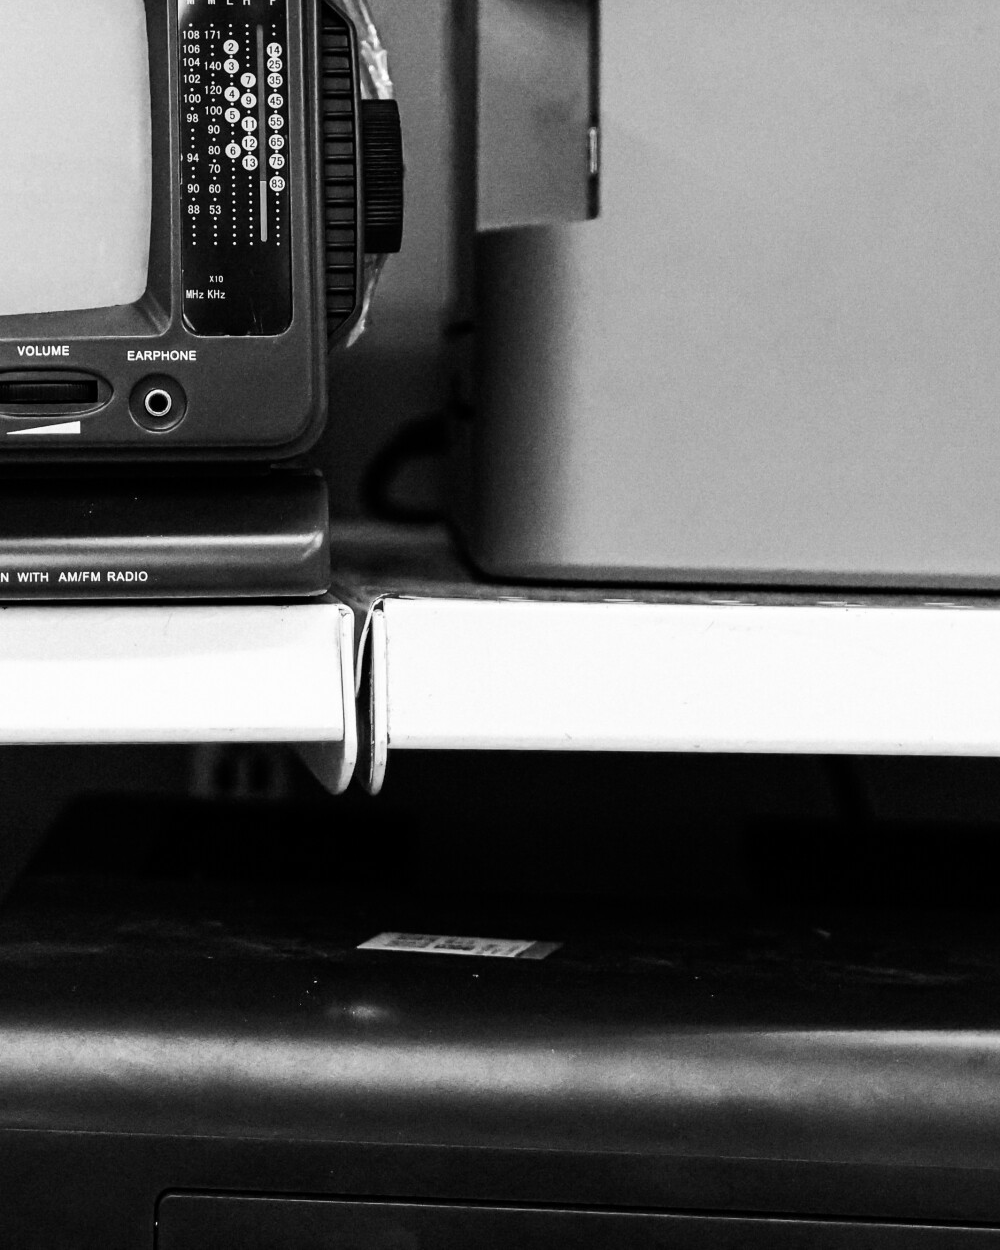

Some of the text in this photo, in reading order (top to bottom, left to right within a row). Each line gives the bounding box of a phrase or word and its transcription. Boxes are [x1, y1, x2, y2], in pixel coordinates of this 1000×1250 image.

[182, 30, 200, 40] 108
[204, 30, 221, 40] 171
[182, 44, 201, 54] 106
[268, 44, 281, 56] 14
[182, 57, 201, 67] 104
[204, 61, 222, 71] 140
[268, 59, 282, 70] 25
[183, 73, 201, 84] 102
[268, 74, 282, 86] 35
[204, 84, 223, 95] 120
[183, 93, 202, 104] 100
[268, 95, 283, 107] 45
[204, 105, 223, 116] 100
[186, 113, 199, 123] 98
[269, 116, 283, 128] 55
[207, 124, 221, 135] 90
[243, 119, 256, 130] 11
[243, 137, 256, 149] 12
[269, 136, 284, 148] 65
[207, 145, 221, 155] 80
[186, 152, 200, 163] 94
[243, 157, 257, 169] 13
[270, 155, 284, 167] 75
[208, 163, 221, 174] 70
[187, 183, 200, 194] 90
[208, 183, 221, 194] 60
[271, 178, 284, 190] 83
[187, 204, 201, 215] 88
[209, 204, 222, 215] 53
[209, 275, 224, 283] X10
[185, 289, 226, 299] MHz KHz
[16, 345, 70, 357] VOLUME
[127, 349, 197, 362] EARPHONE
[16, 571, 49, 583] WITH
[58, 571, 101, 583] AM/FM
[106, 570, 149, 582] RADIO
